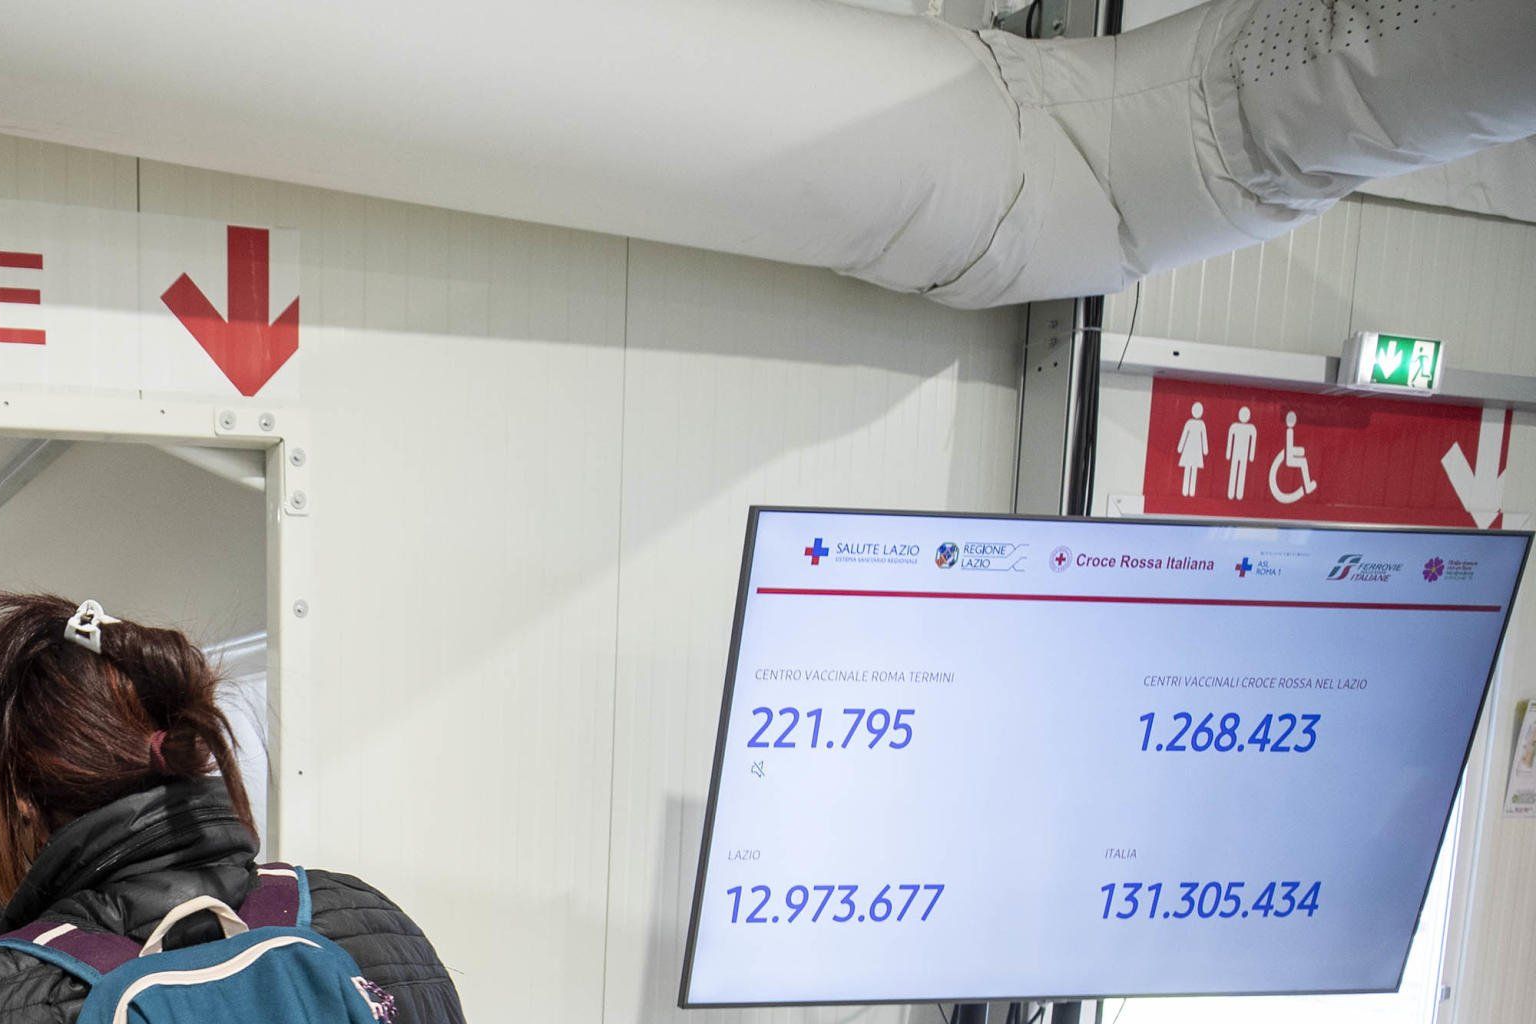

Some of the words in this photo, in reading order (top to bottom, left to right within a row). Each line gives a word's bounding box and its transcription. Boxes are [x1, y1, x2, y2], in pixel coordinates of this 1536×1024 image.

[836, 542, 880, 555] SALUTE
[883, 544, 920, 556] LAZIO
[964, 543, 1007, 555] REGIONE
[962, 558, 991, 569] LAZIO
[1076, 553, 1116, 568] Croce
[1120, 555, 1162, 569] Rossa
[1166, 556, 1215, 571] Italiana
[1358, 562, 1404, 572] FERROVIE
[1350, 573, 1392, 583] ITALIANE
[755, 668, 802, 681] CENTRO
[804, 670, 868, 682] VACCINALE
[871, 671, 906, 683] ROMA
[908, 671, 955, 683] TERMINI
[1143, 675, 1182, 687] CENTRI
[1184, 676, 1239, 688] VACCINALI
[1241, 676, 1277, 689] CROCE
[1278, 677, 1312, 689] ROSSA
[1314, 678, 1335, 690] NEL
[1337, 678, 1368, 690] LAZIO
[747, 706, 916, 749] 221.795
[1139, 711, 1322, 753] 1.268.423
[727, 849, 761, 861] LAZIO
[1104, 848, 1137, 860] ITALIA
[726, 884, 945, 924] 12.973.677
[1100, 881, 1322, 919] 131.305.434
